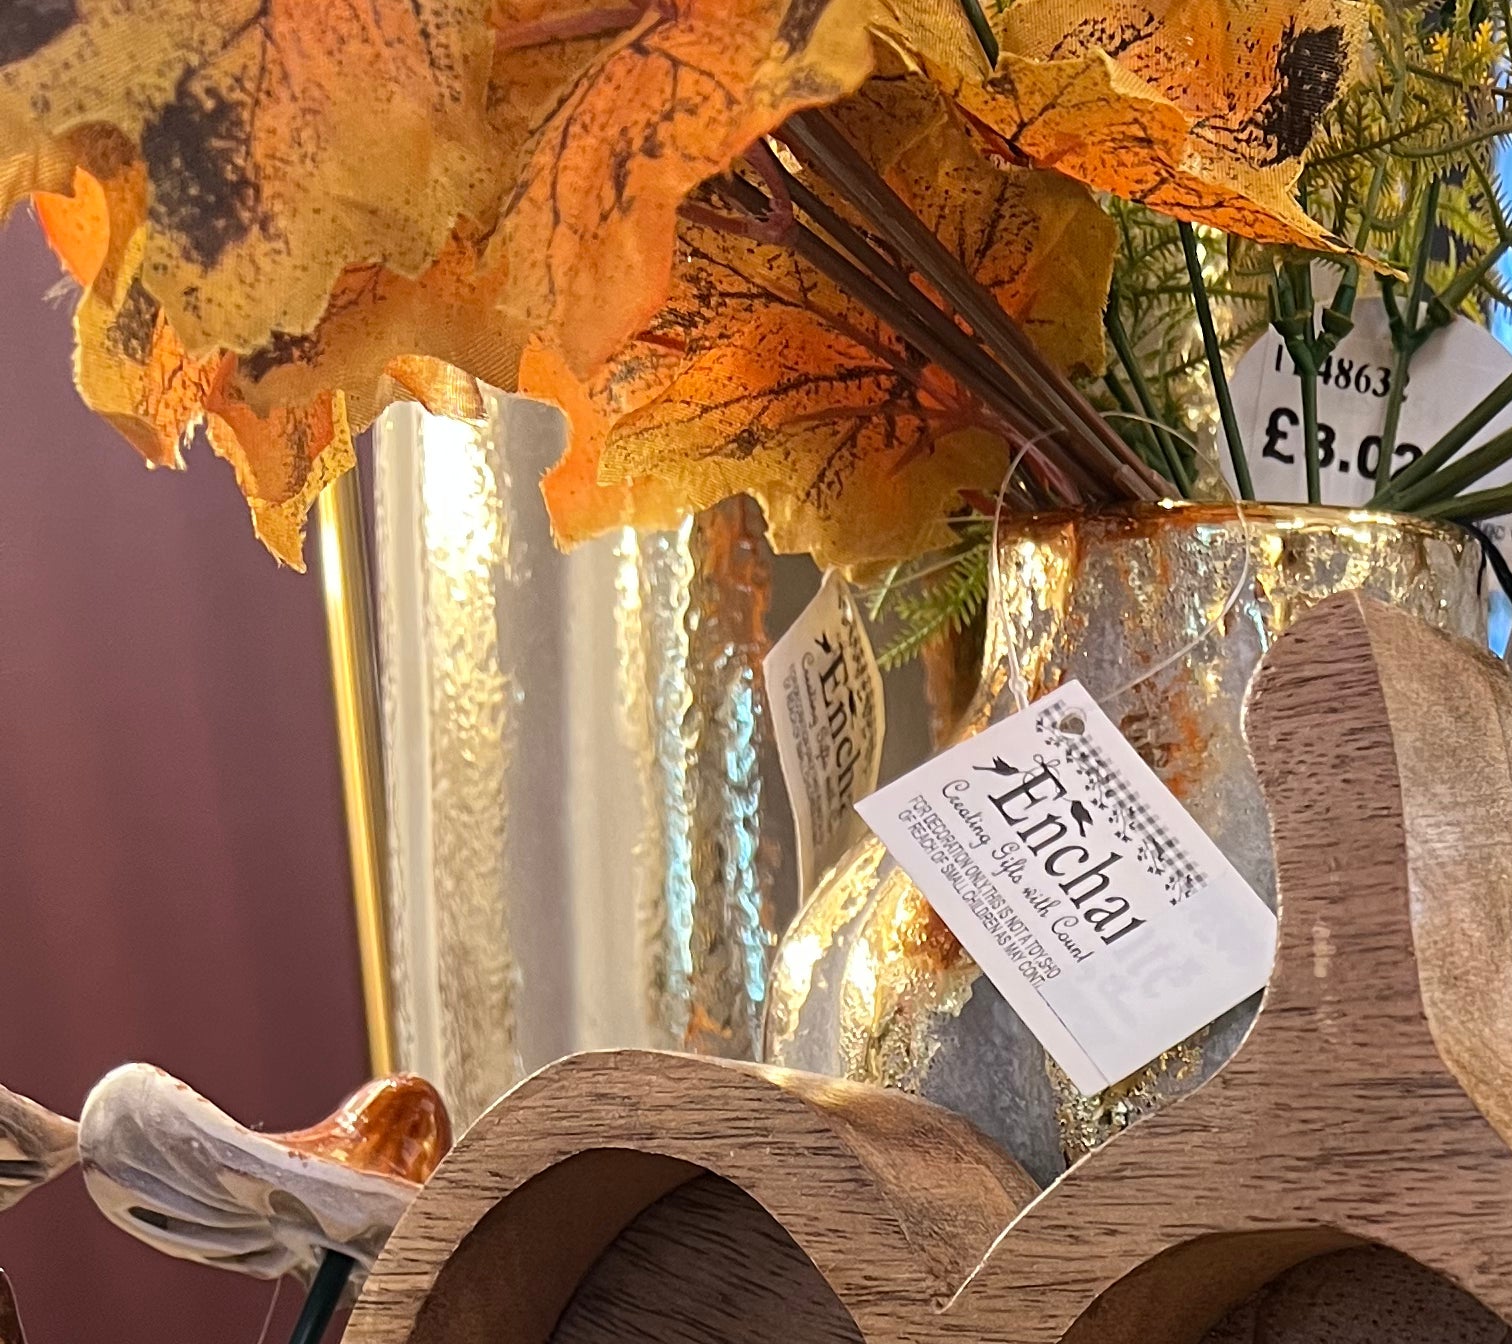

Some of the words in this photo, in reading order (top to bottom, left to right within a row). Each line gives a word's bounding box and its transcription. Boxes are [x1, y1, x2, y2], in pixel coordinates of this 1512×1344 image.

[898, 809, 917, 822] OF
[908, 794, 933, 817] FOR
[907, 821, 940, 855] REACH
[923, 812, 974, 869] DECORATION
[942, 779, 991, 850] Creating
[991, 841, 1028, 884] Gifts
[1022, 886, 1062, 918] with
[930, 850, 950, 864] OF
[940, 863, 970, 895] SMALL
[961, 889, 1002, 935] CHILDREN
[996, 905, 1014, 919] IS
[1004, 915, 1030, 936] NOT
[994, 929, 1012, 946] AS
[1018, 933, 1033, 945] A
[1004, 942, 1027, 963] MAY
